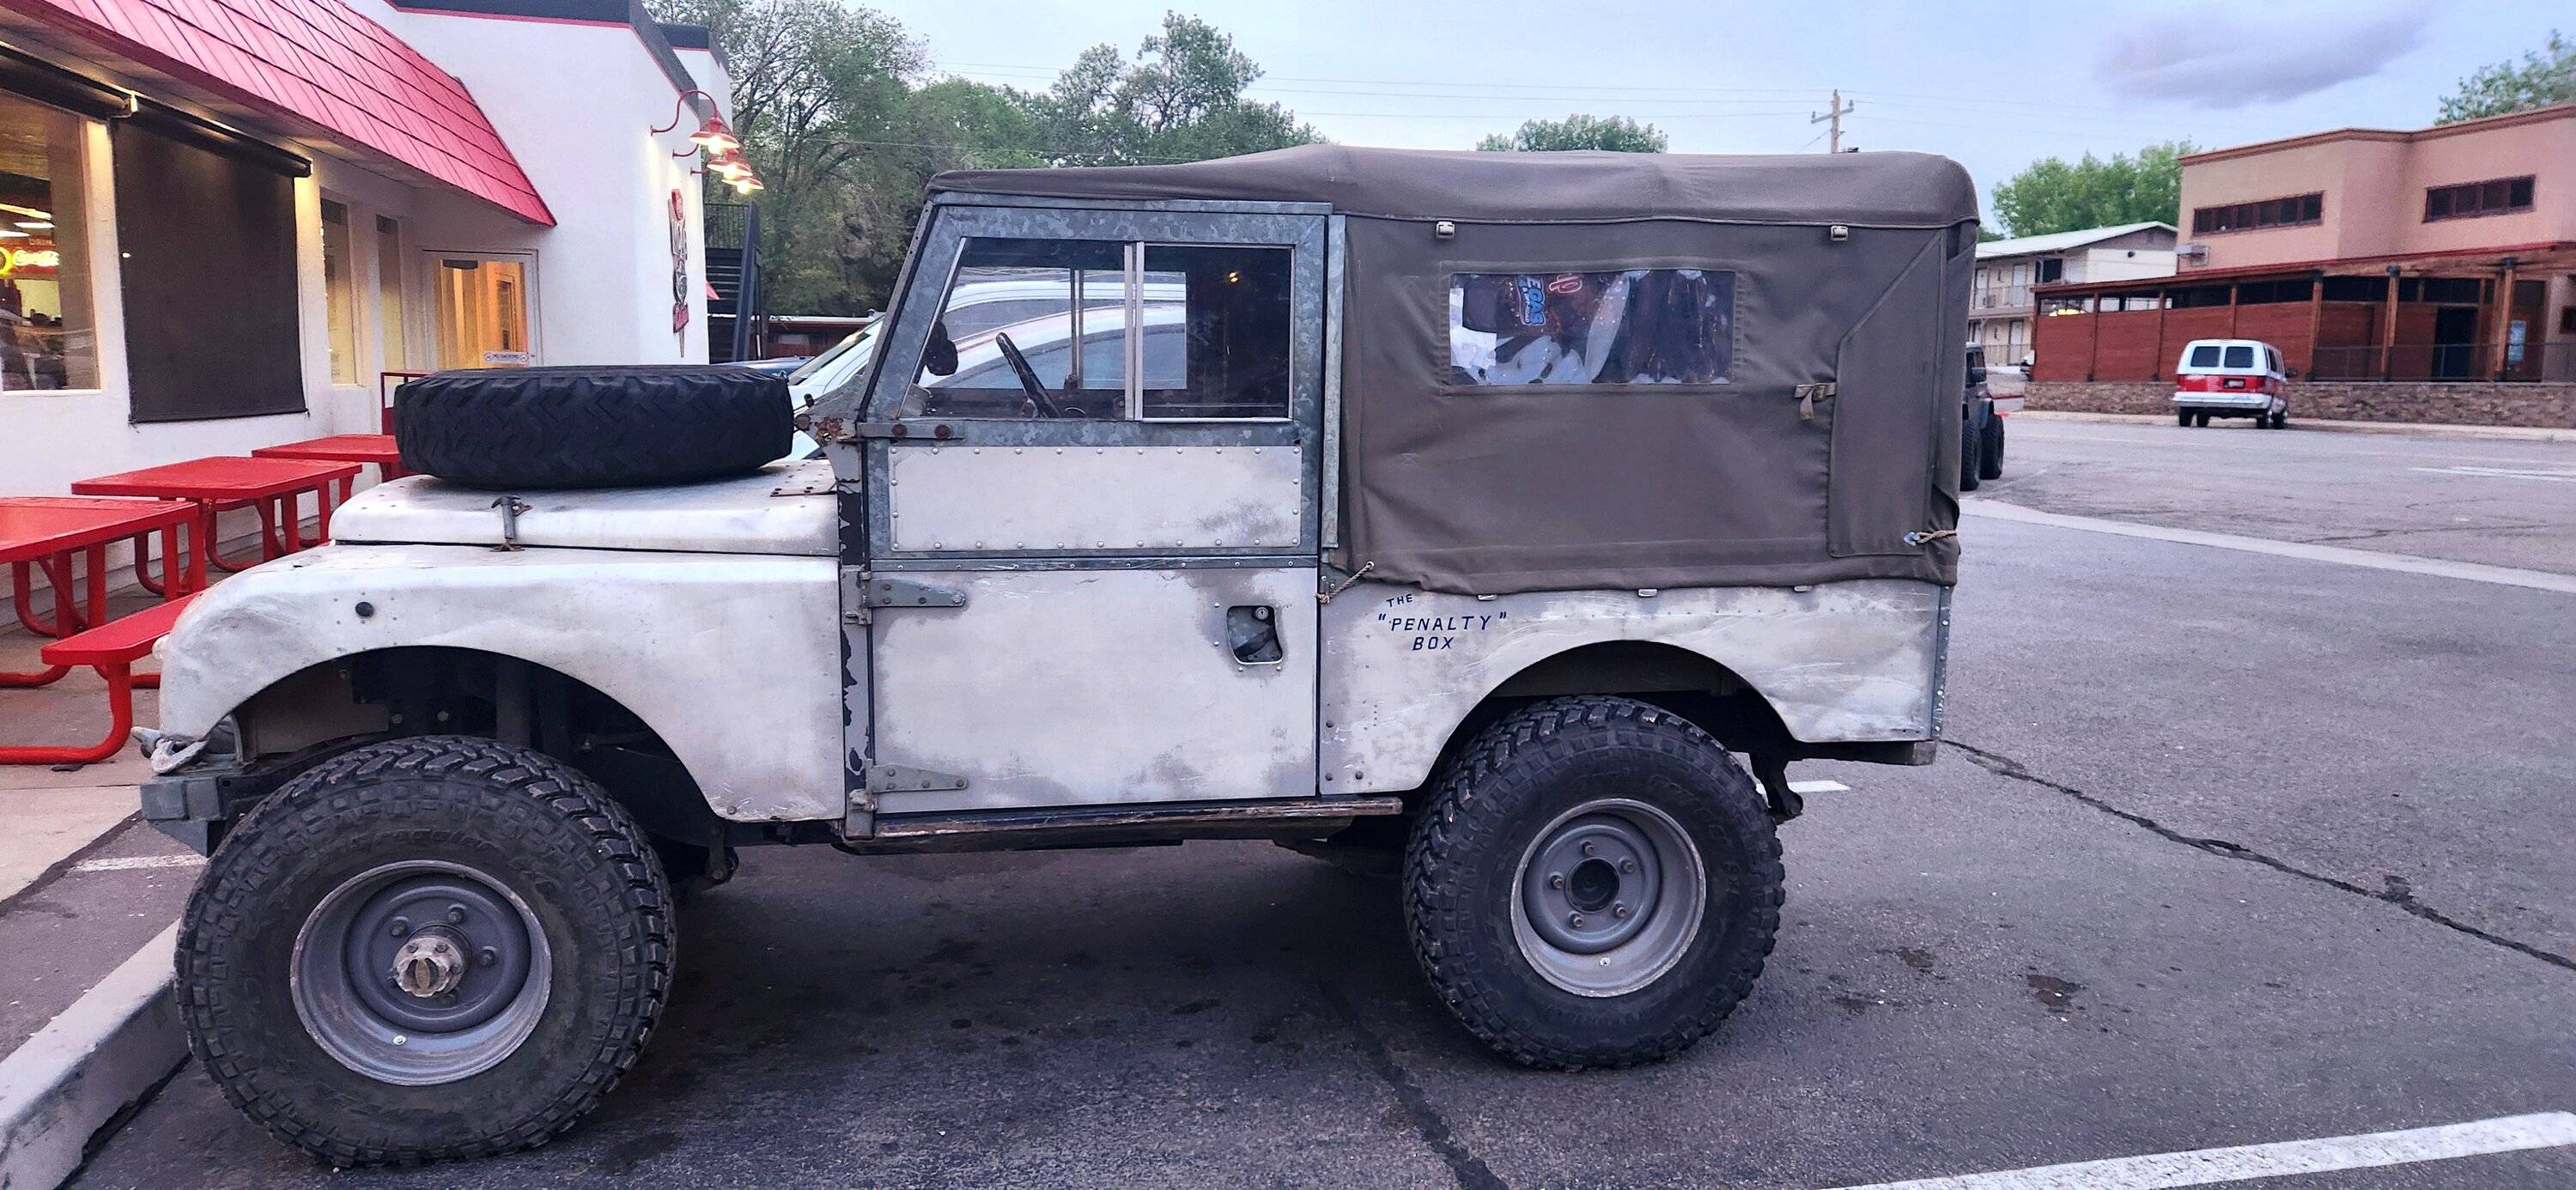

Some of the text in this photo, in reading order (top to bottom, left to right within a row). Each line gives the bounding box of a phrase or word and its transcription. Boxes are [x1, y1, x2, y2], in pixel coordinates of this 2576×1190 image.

[1386, 593, 1413, 608] THE
[1378, 611, 1507, 632] "PENALTY"
[1412, 636, 1455, 652] BOX
